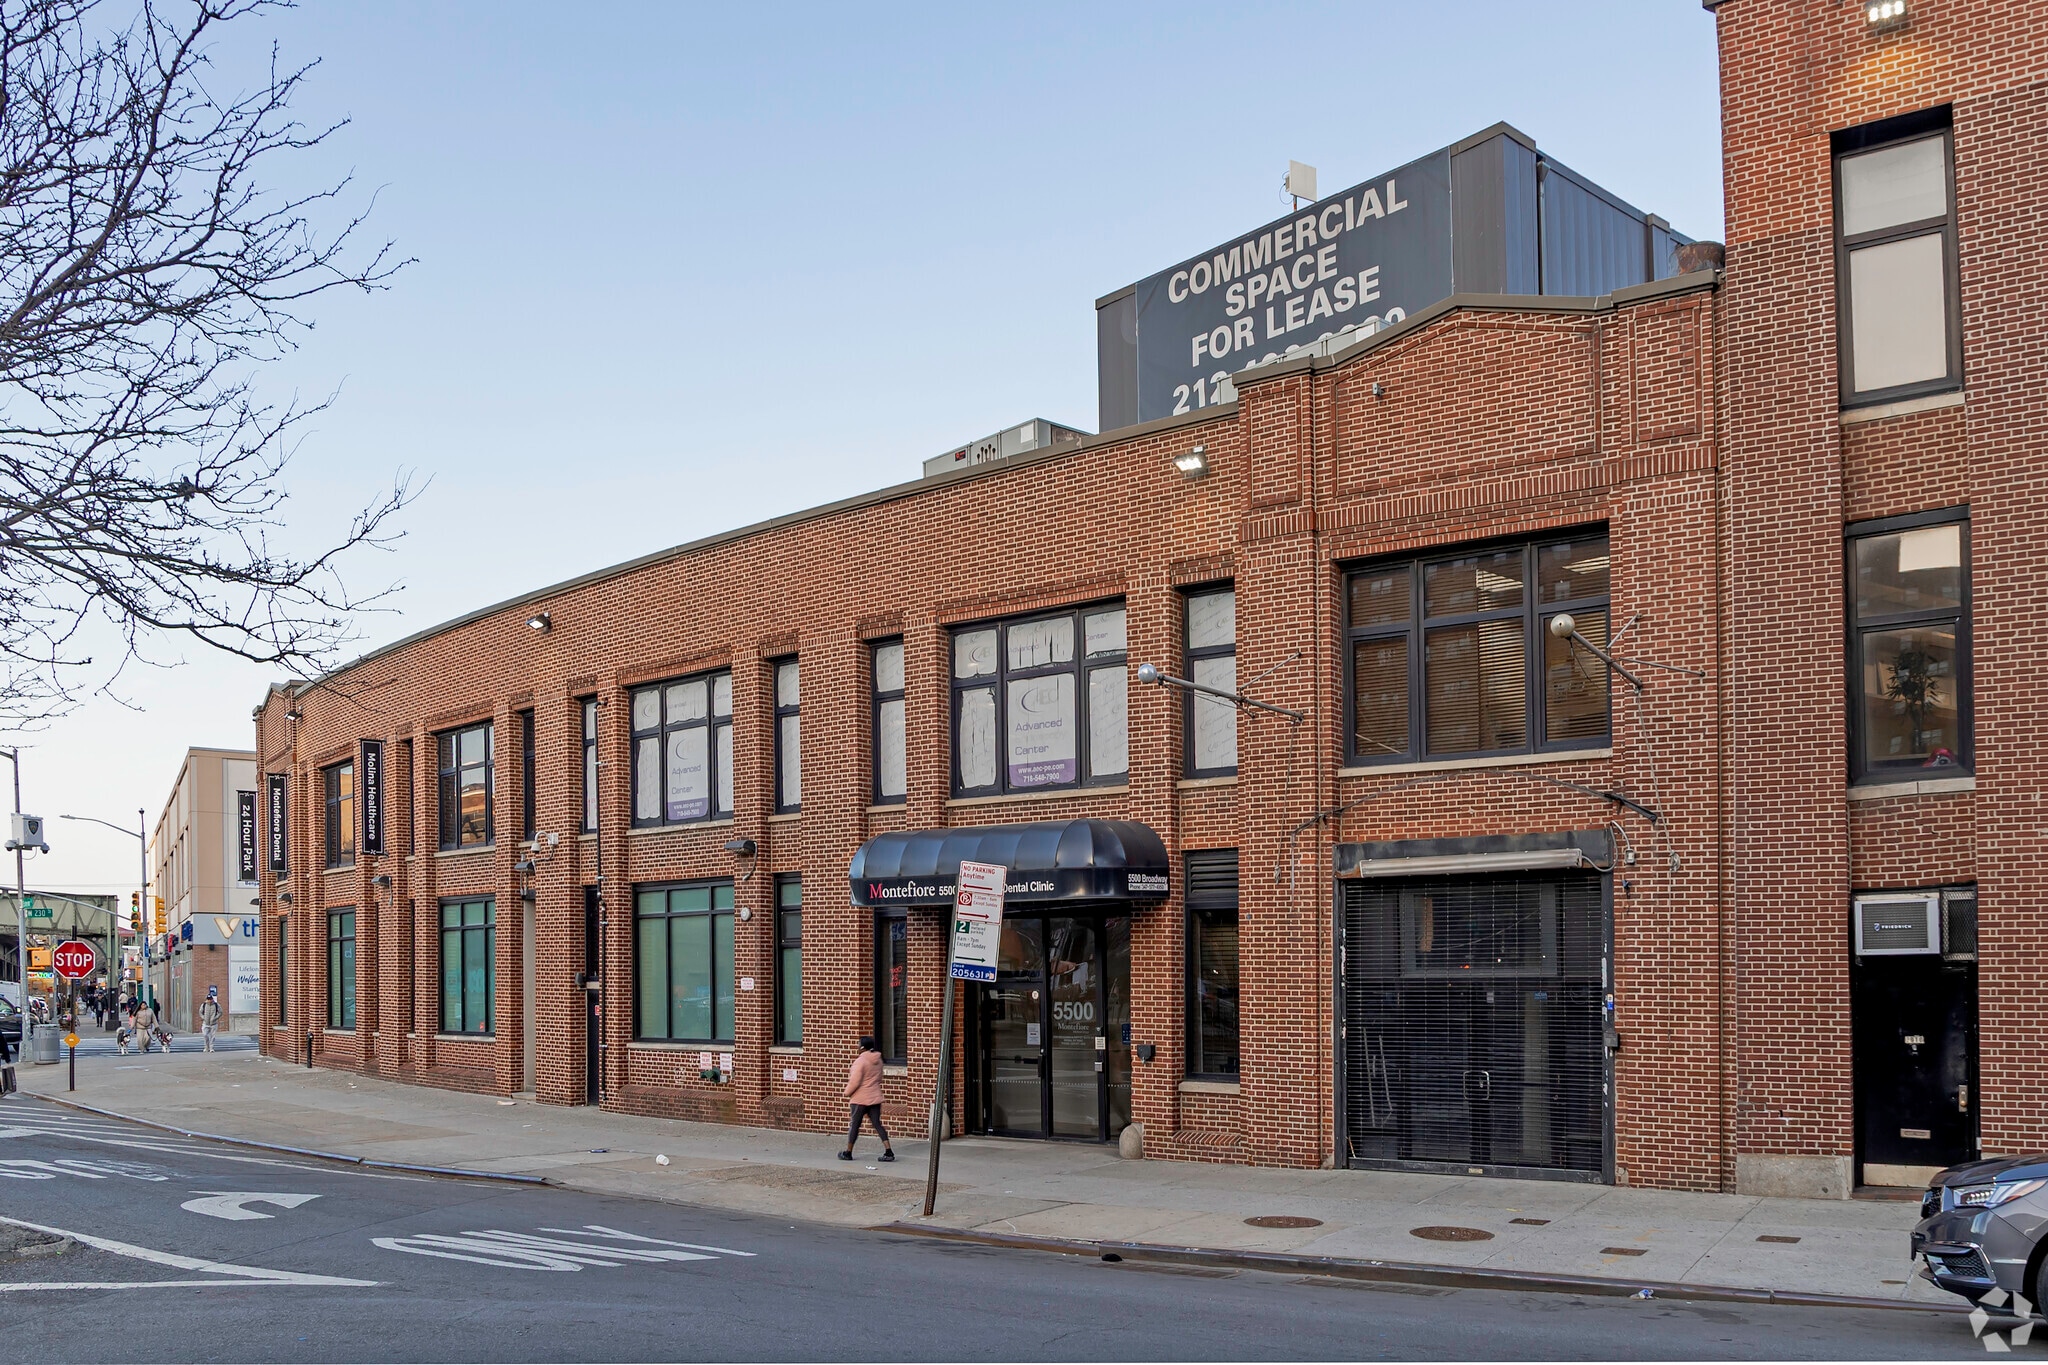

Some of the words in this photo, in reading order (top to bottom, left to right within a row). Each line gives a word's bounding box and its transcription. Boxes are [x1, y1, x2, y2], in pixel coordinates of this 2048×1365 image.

[1168, 178, 1408, 304] COMMERCIAL
[1225, 243, 1338, 317] SPACE
[1192, 316, 1255, 367] FOR
[1266, 265, 1381, 339] LEASE
[1015, 718, 1063, 732] Advanced
[1014, 745, 1049, 756] Center
[367, 753, 376, 785] Molina
[671, 765, 701, 775] Advanced
[671, 786, 693, 795] Center
[242, 805, 250, 817] 24
[273, 788, 281, 833] Montefiore
[368, 787, 377, 840] Healthcare
[242, 820, 252, 846] Hour
[273, 834, 282, 862] Dental
[243, 848, 254, 872] Park
[963, 872, 985, 880] Anytime
[972, 866, 996, 875] PARKING
[1127, 873, 1141, 883] 5500
[1141, 873, 1168, 884] Broadway
[869, 881, 935, 899] Montefiore
[1030, 880, 1055, 892] Clinic
[959, 921, 967, 932] 2
[55, 953, 93, 967] STOP
[952, 968, 984, 979] 205631
[1053, 1001, 1094, 1020] 5500
[1057, 1022, 1090, 1031] Montefiore
[369, 1224, 758, 1272] ONLY
